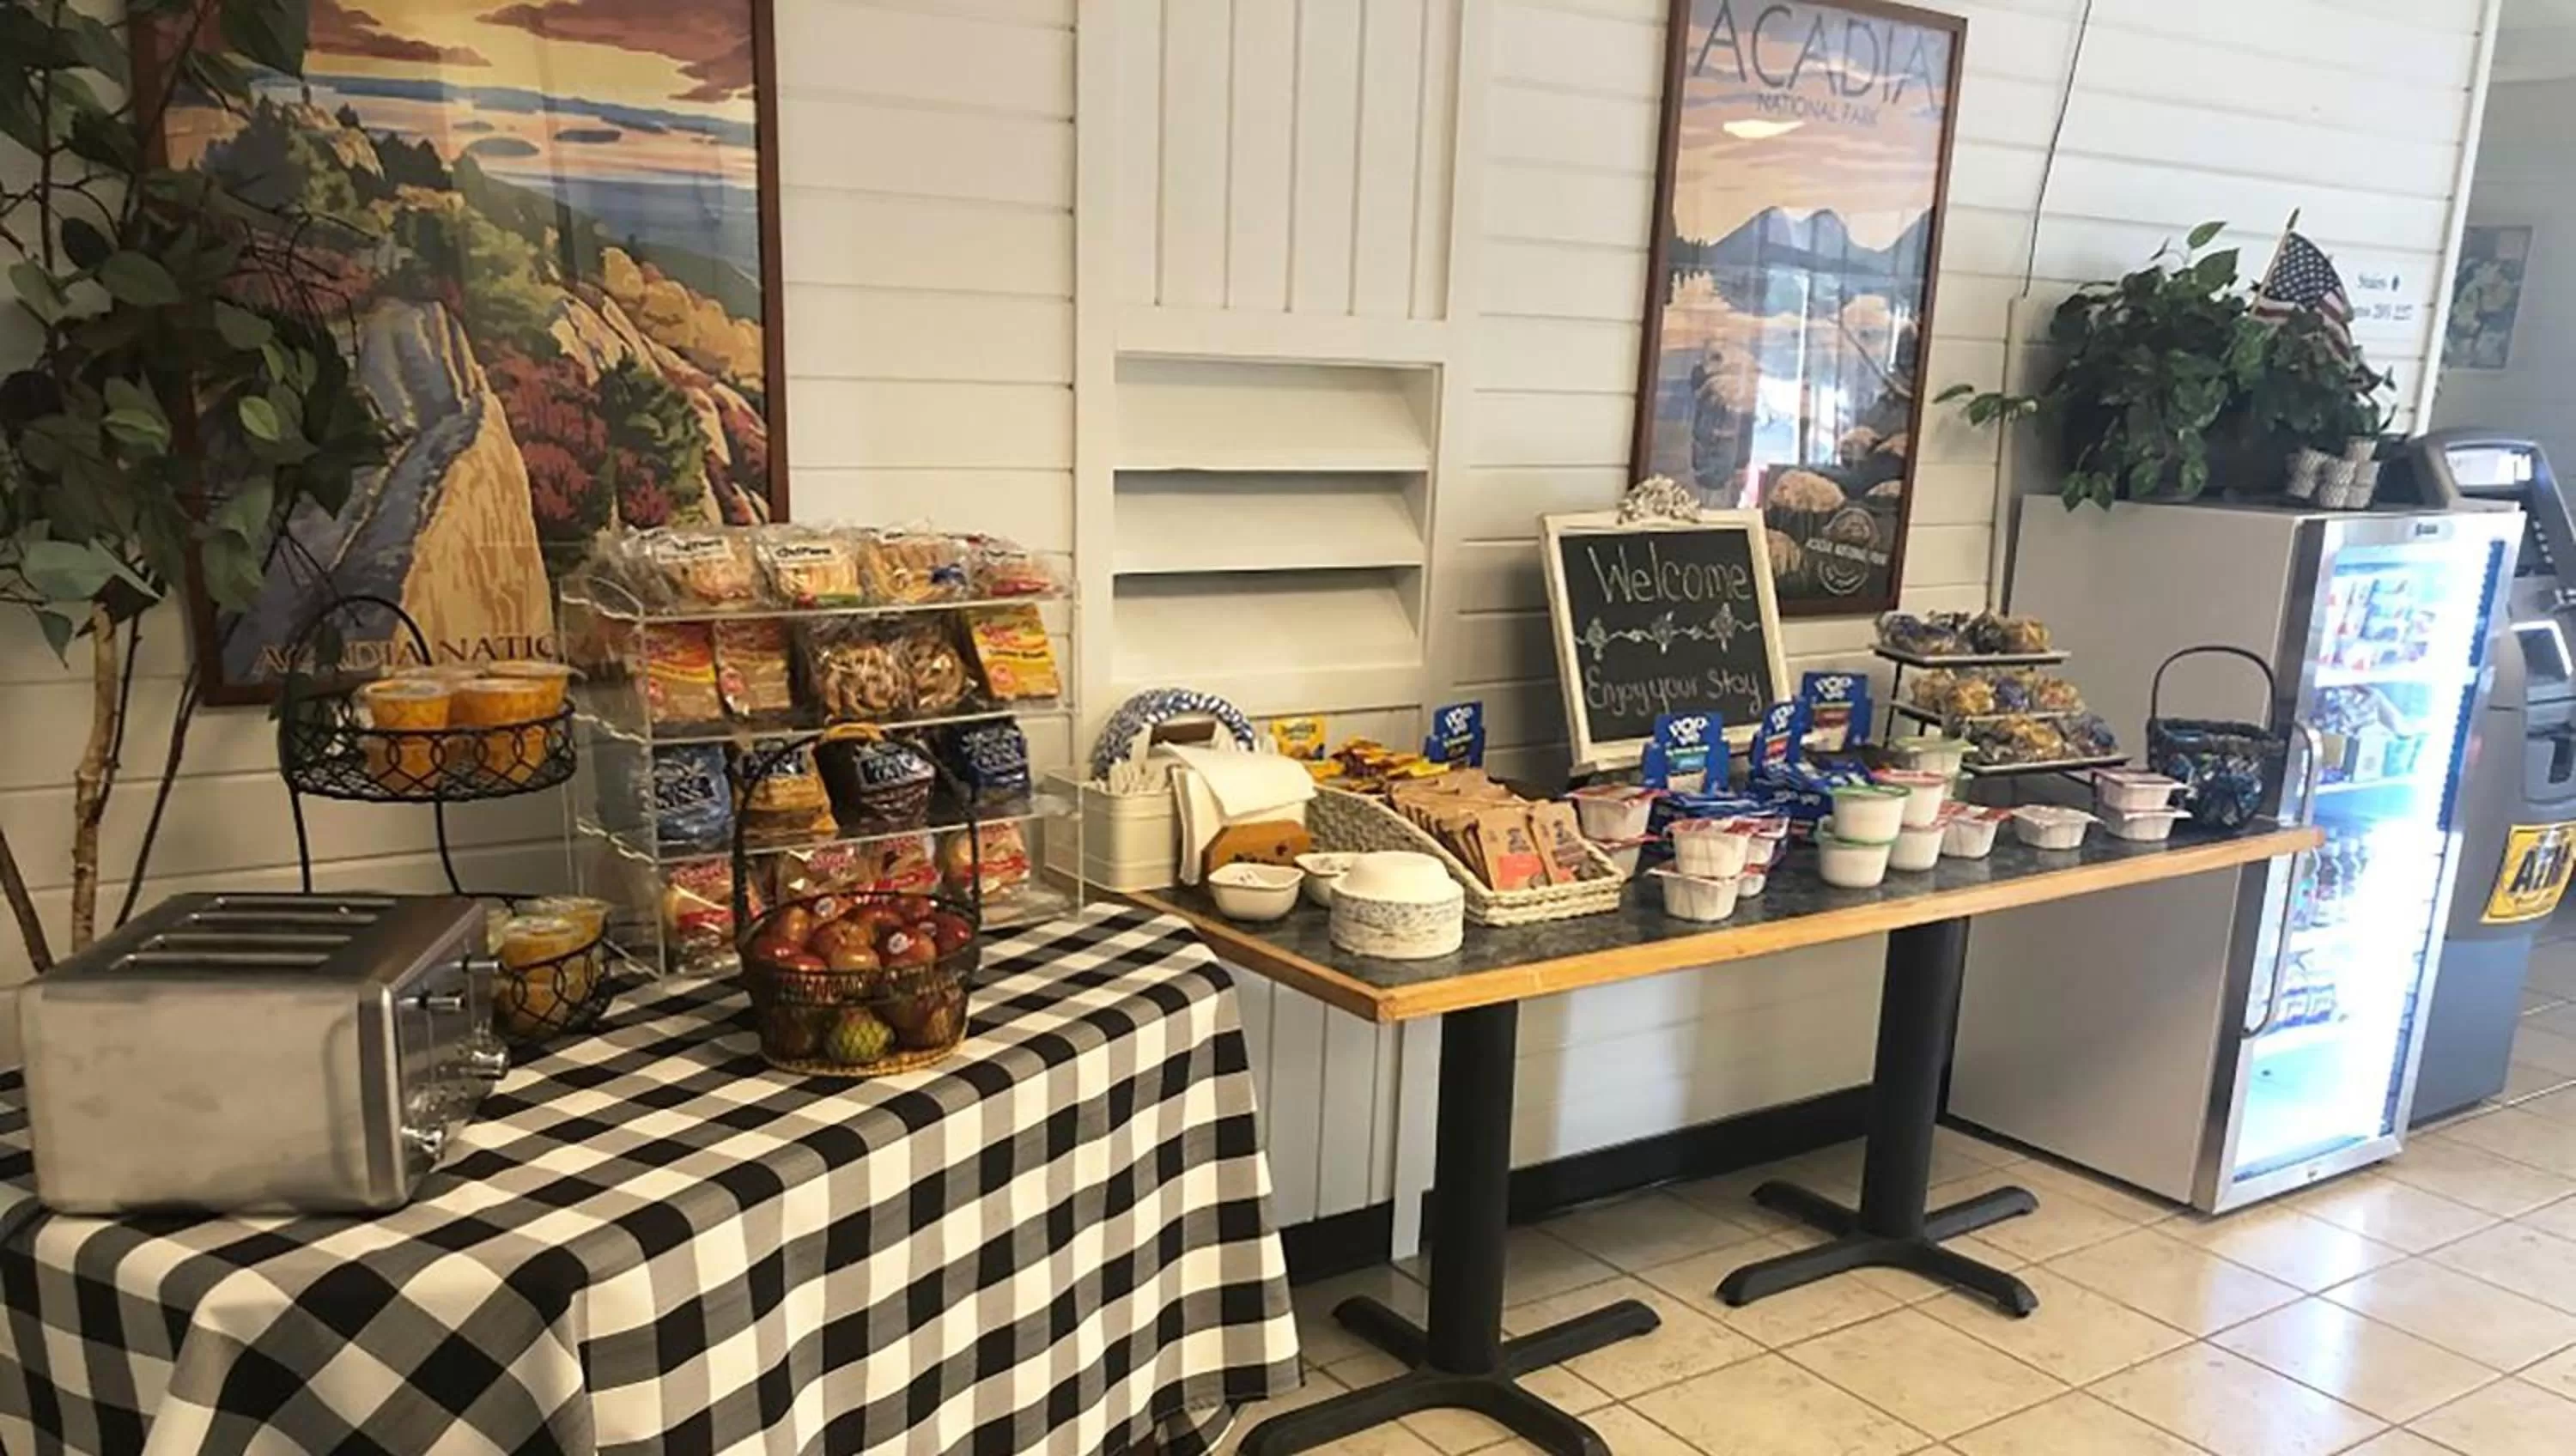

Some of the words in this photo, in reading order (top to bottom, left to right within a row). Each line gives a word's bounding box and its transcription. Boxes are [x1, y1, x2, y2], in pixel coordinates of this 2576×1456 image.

[1693, 2, 1939, 112] ACADIA
[1756, 92, 1840, 122] NATIONAL
[1587, 540, 1753, 604] Welcome
[1585, 665, 1651, 716] Enjoy
[1648, 676, 1698, 715] your
[1705, 667, 1762, 716] Stay
